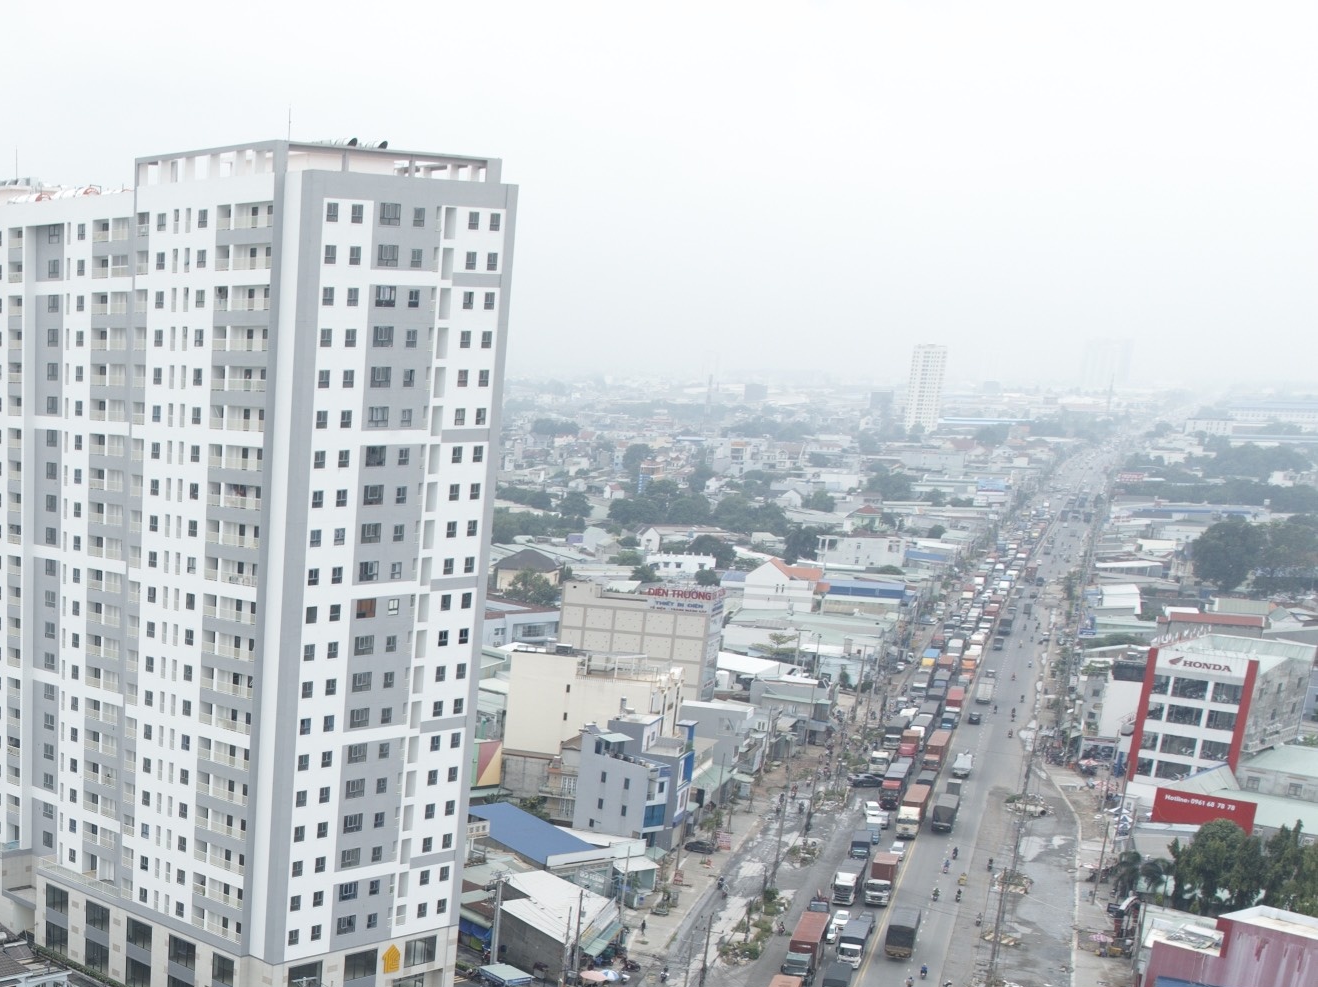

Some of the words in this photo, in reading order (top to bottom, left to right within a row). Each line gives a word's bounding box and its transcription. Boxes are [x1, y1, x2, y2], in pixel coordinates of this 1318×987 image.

[1183, 660, 1232, 673] HONDA
[1190, 798, 1205, 807] 0961
[1217, 802, 1225, 810] 78
